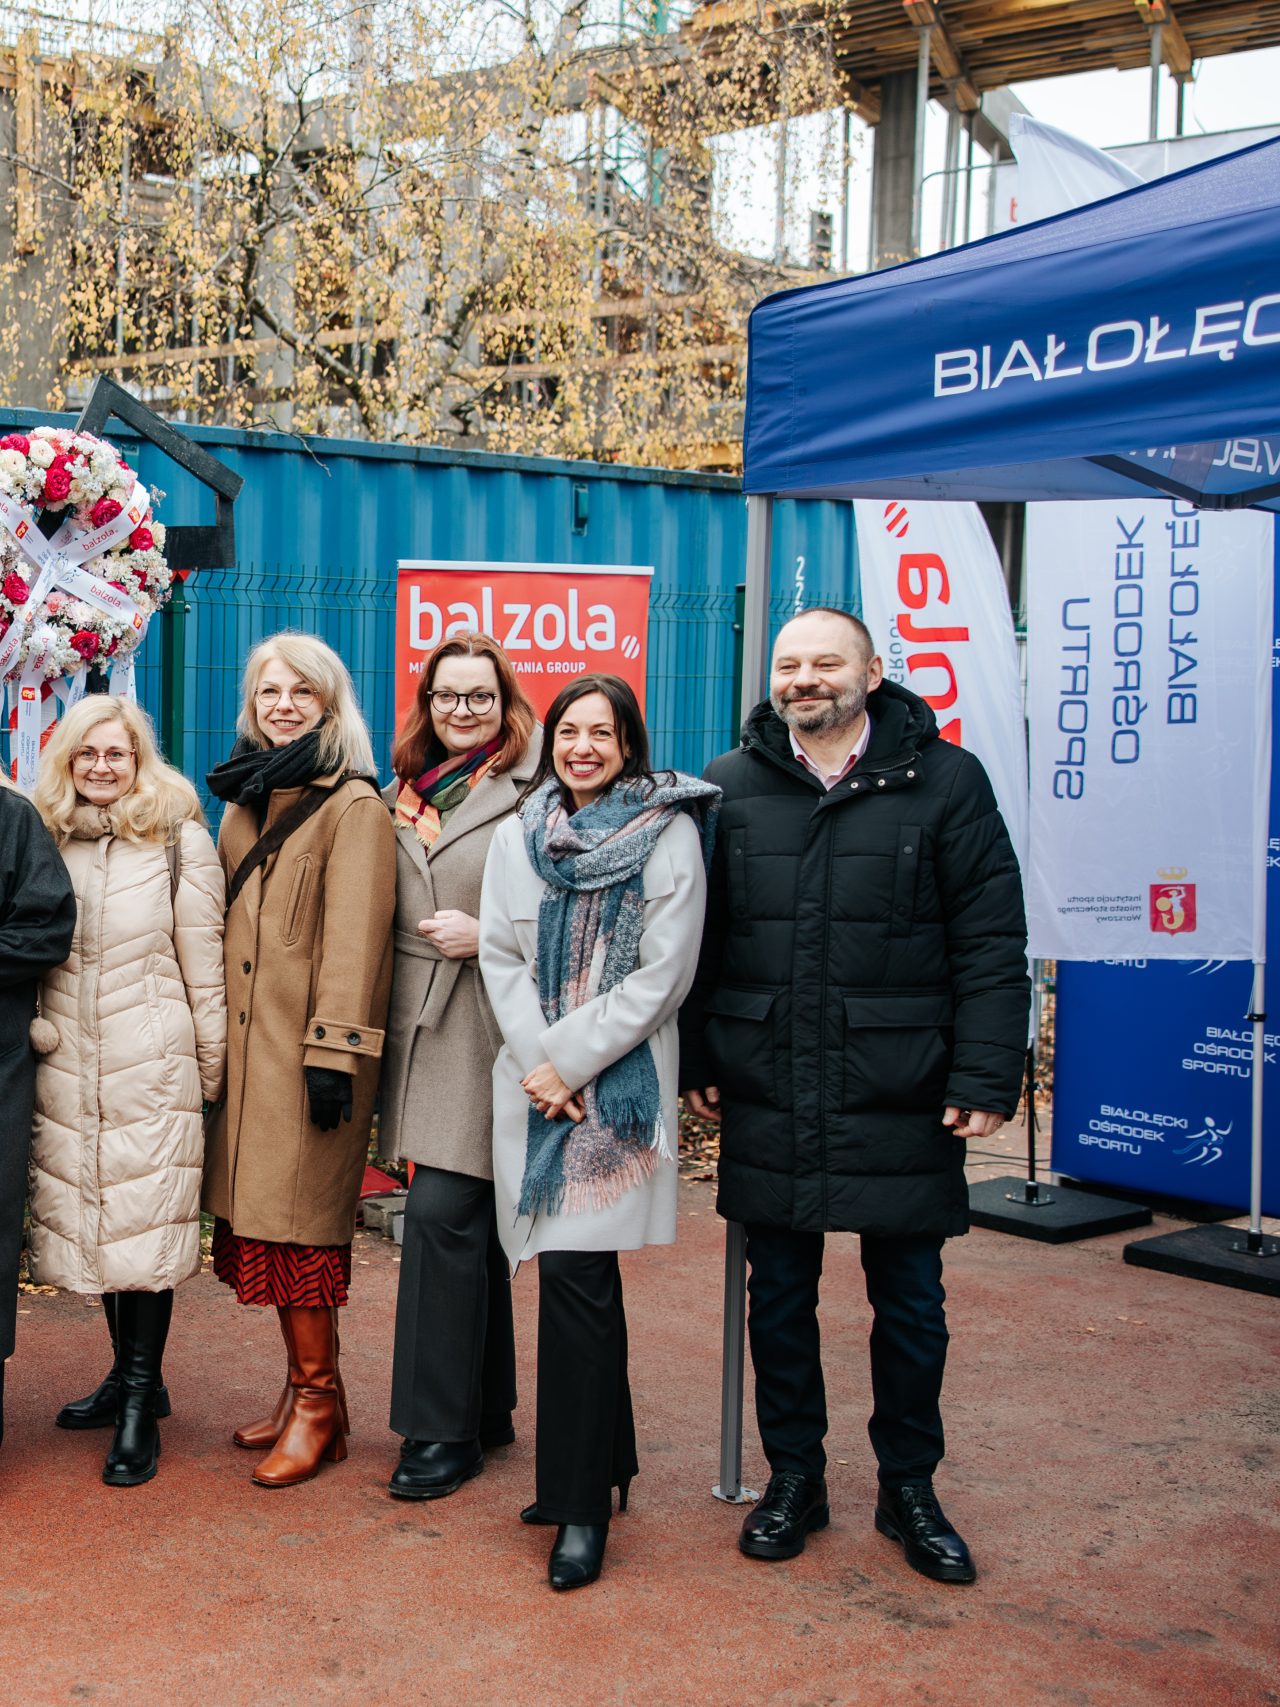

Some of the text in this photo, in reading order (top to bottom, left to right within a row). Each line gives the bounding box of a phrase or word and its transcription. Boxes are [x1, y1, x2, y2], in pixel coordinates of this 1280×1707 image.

[933, 294, 1280, 397] BIAŁOŁĘC
[82, 528, 116, 551] balzola
[90, 585, 121, 607] balzola
[410, 585, 616, 650] balzola
[547, 662, 586, 673] GROUP
[1193, 1042, 1277, 1064] OŚRODK
[1181, 1058, 1250, 1078] SPORTU
[1100, 1104, 1188, 1129] BIAŁOŁĘCKI
[1089, 1119, 1165, 1143] OŚRODEK
[1078, 1133, 1142, 1155] SPORTU
